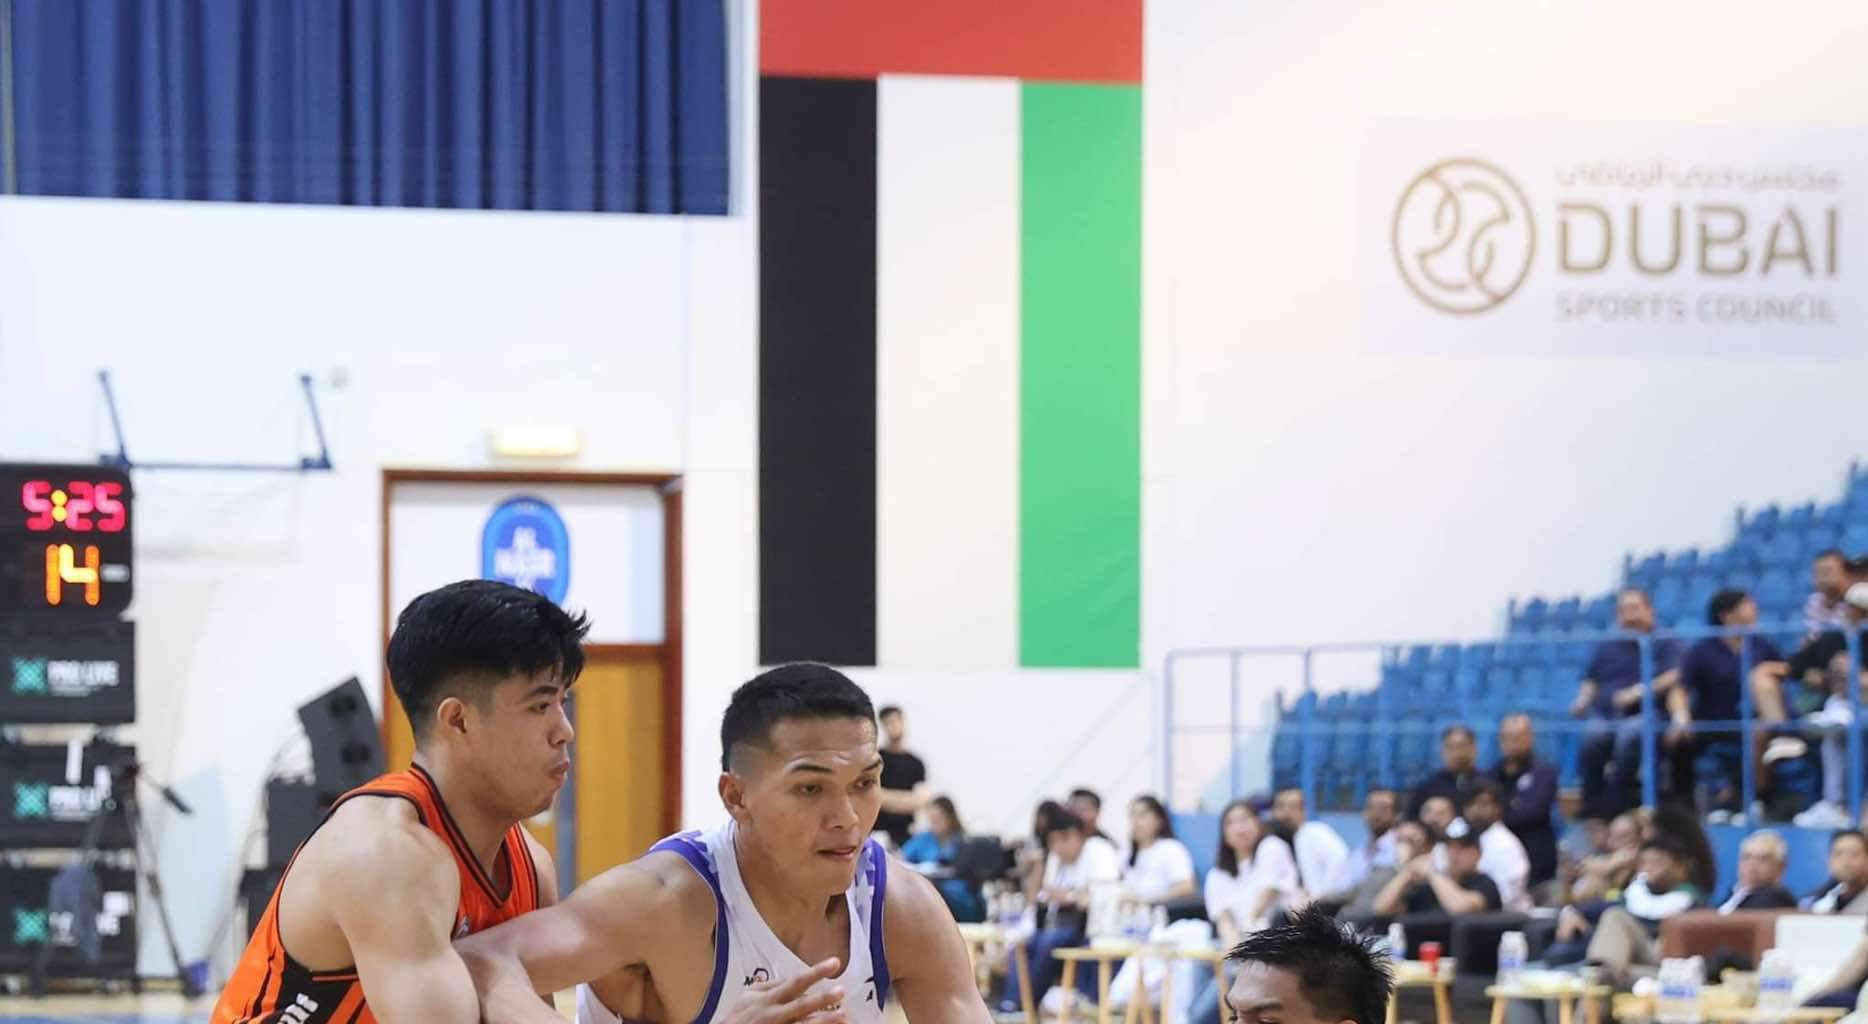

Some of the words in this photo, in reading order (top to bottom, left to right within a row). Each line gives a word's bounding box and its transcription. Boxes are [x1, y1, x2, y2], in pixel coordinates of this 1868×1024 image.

[1556, 203, 1840, 278] DUBAI
[1556, 293, 1687, 325] SPORTS
[1696, 293, 1840, 325] COUNCIL
[22, 481, 126, 532] 5:25
[46, 544, 100, 605] 14
